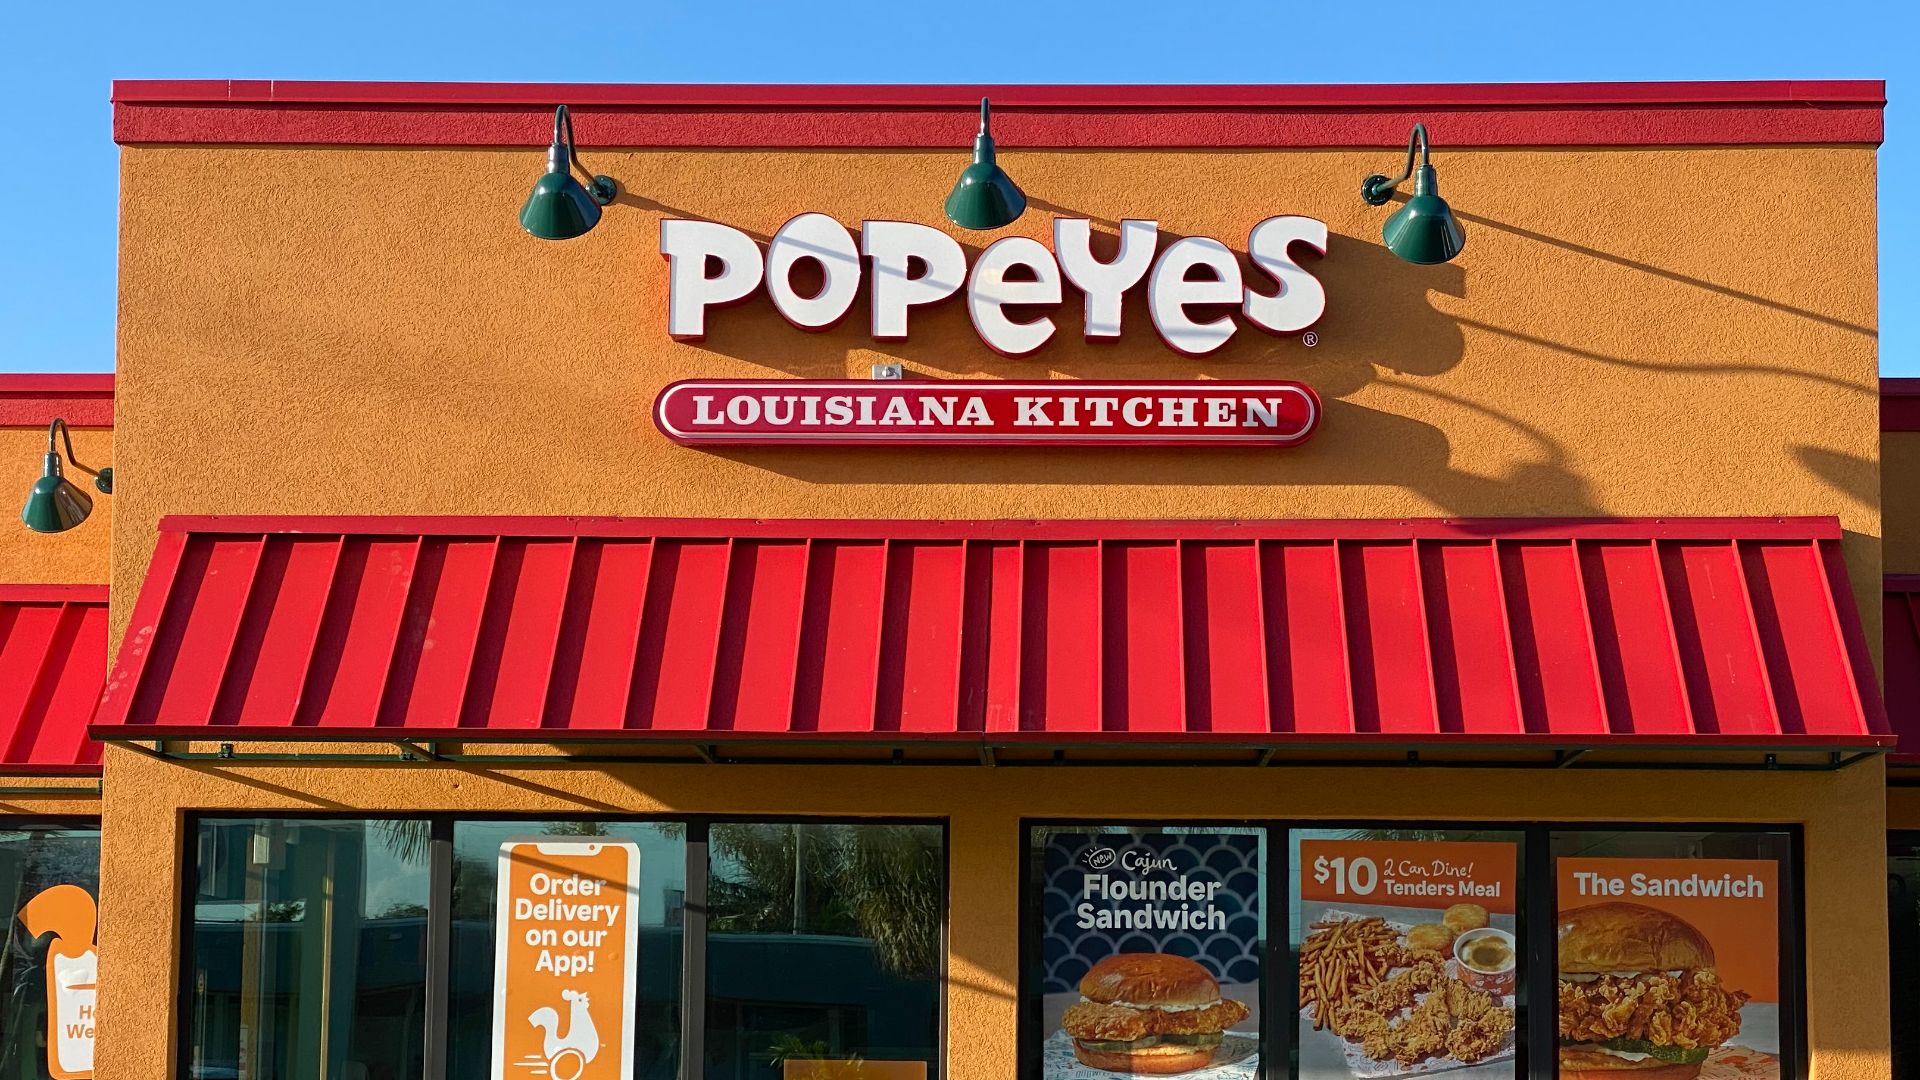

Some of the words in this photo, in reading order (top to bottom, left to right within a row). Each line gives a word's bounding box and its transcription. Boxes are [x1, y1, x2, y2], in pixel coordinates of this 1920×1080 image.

[692, 395, 995, 427] LOUISIANA
[1013, 396, 1283, 428] KITCHEN
[1121, 850, 1178, 876] Cajun
[1313, 855, 1378, 895] $10
[1383, 858, 1395, 877] 2
[1399, 860, 1430, 877] Can
[1431, 859, 1473, 878] Dine!
[529, 872, 607, 896] Order
[1083, 873, 1222, 900] Flounder
[1383, 879, 1455, 897] Tenders
[1458, 880, 1500, 897] Meal
[1573, 872, 1625, 896] The
[1630, 872, 1764, 898] Sandwich
[515, 898, 620, 927] Delivery
[1076, 902, 1226, 930] Sandwich
[525, 927, 557, 947] on
[562, 928, 608, 947] our
[535, 949, 594, 977] App!
